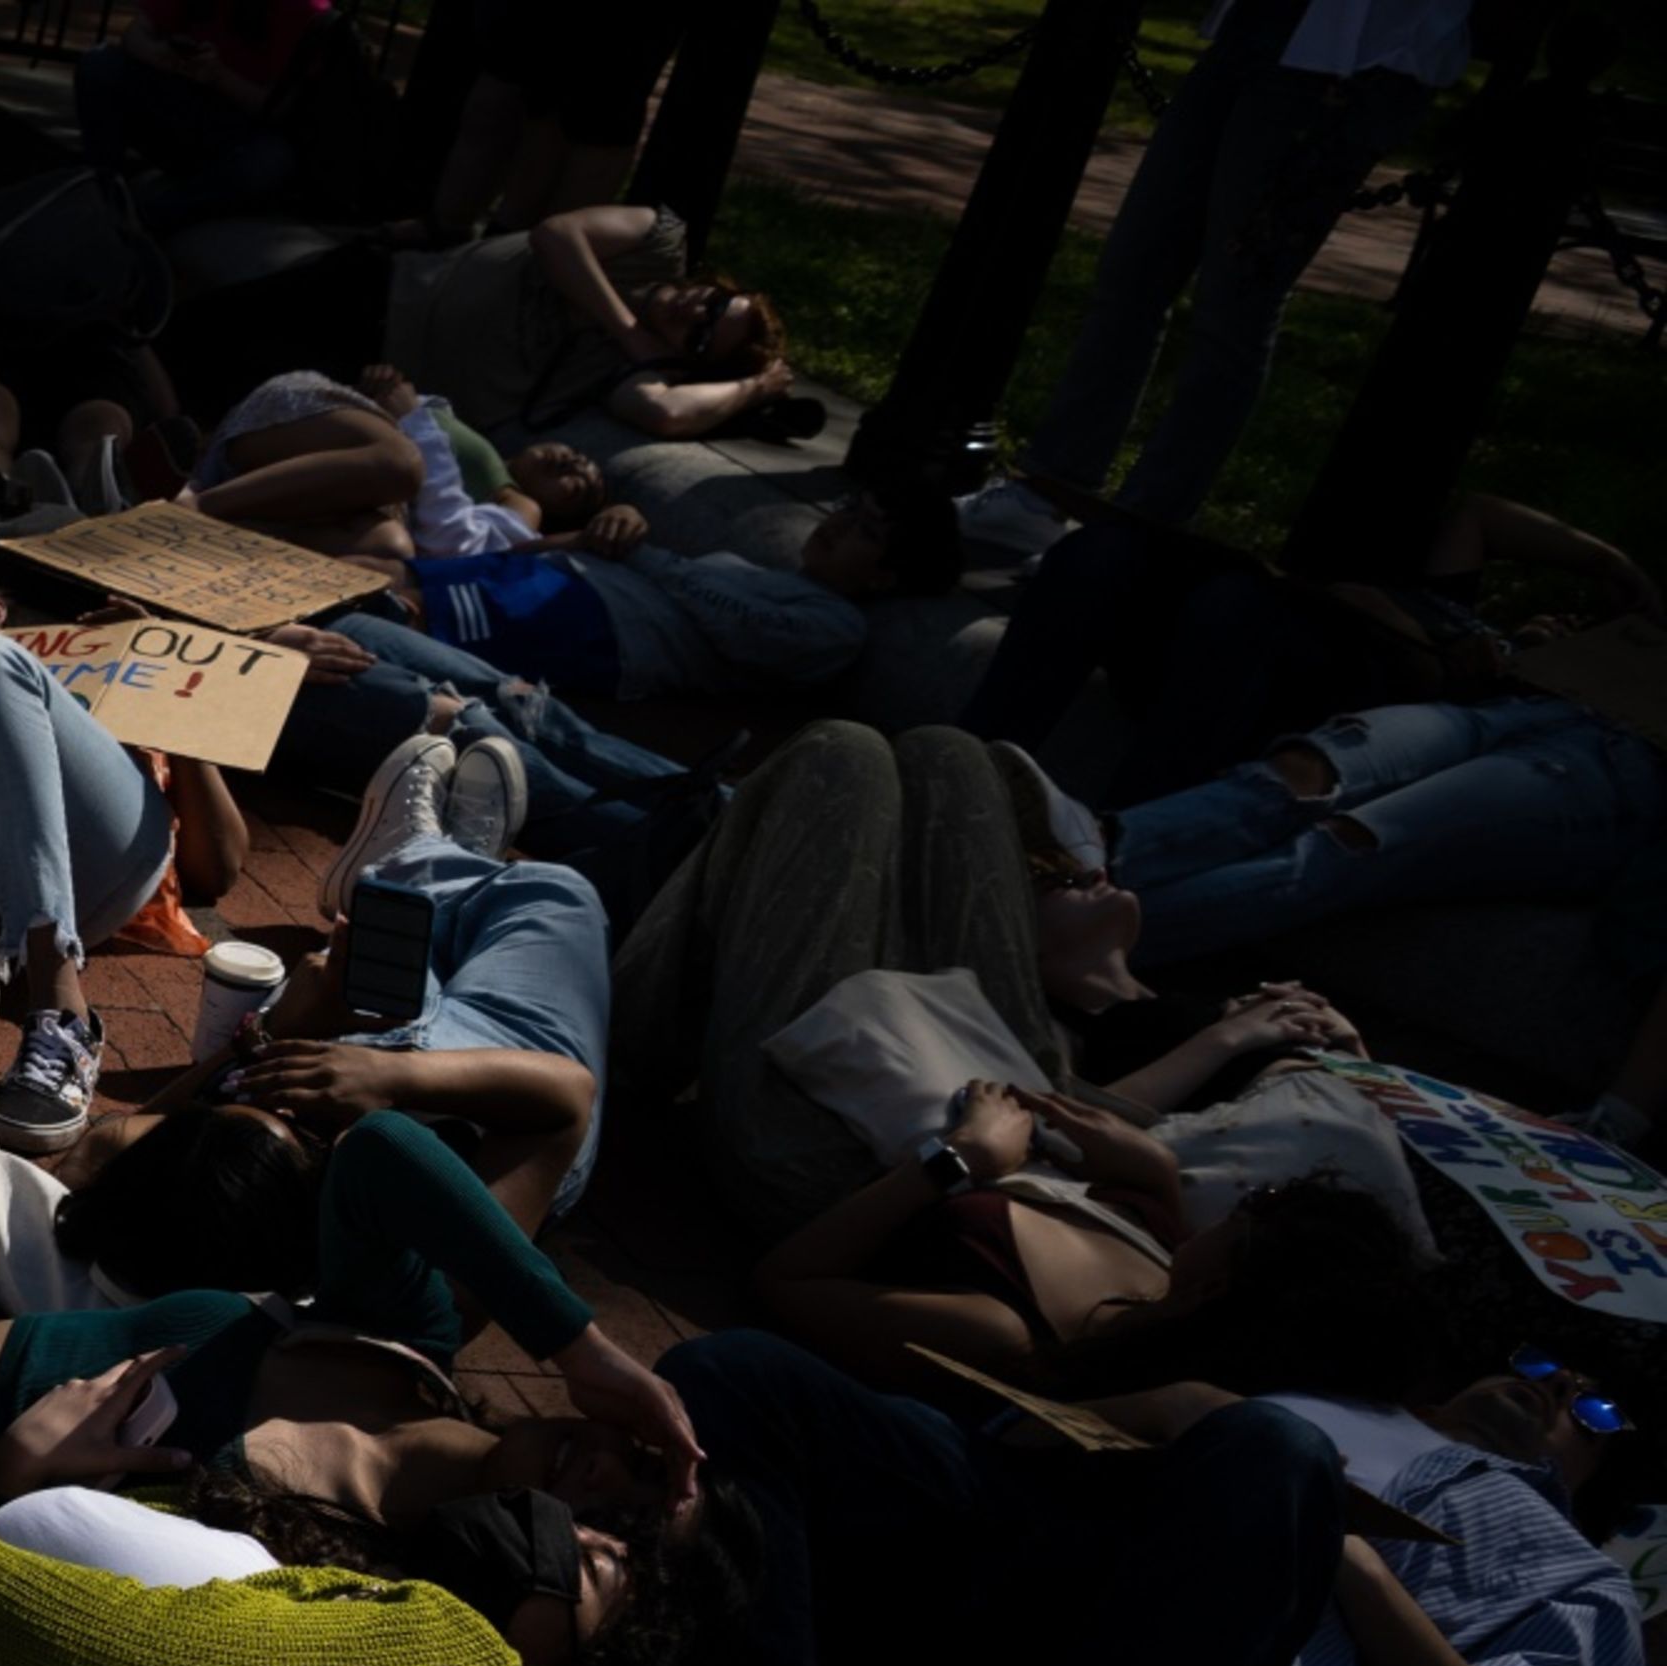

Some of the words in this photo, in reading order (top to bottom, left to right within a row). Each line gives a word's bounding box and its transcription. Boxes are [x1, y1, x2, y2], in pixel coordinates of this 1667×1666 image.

[130, 626, 285, 675] OUT
[1475, 1184, 1624, 1301] YOUR
[1586, 1229, 1667, 1280] IS
